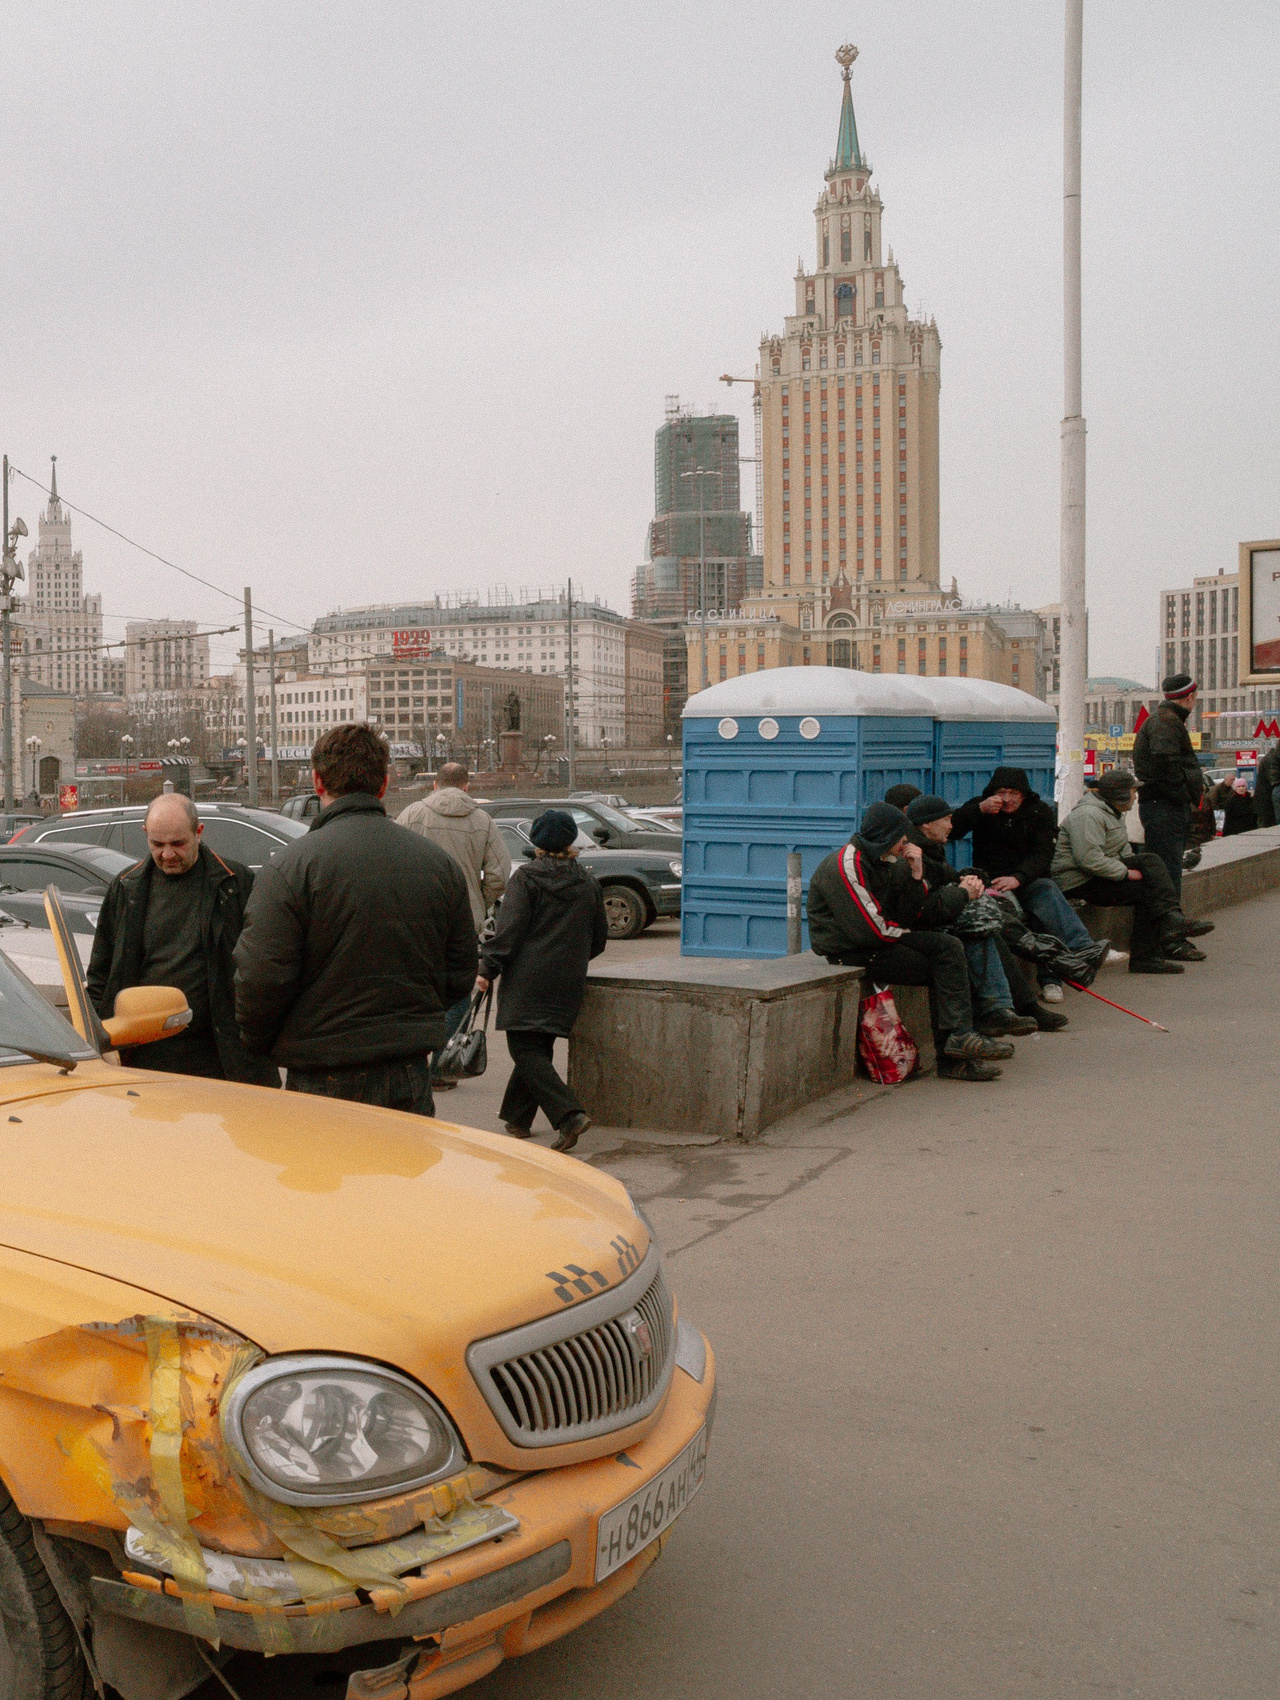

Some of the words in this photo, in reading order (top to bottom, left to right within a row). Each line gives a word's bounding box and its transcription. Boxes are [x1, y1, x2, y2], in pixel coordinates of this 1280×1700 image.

[686, 607, 776, 621] ГОСТИНИЦА
[393, 629, 431, 647] 1929
[1112, 726, 1120, 737] P
